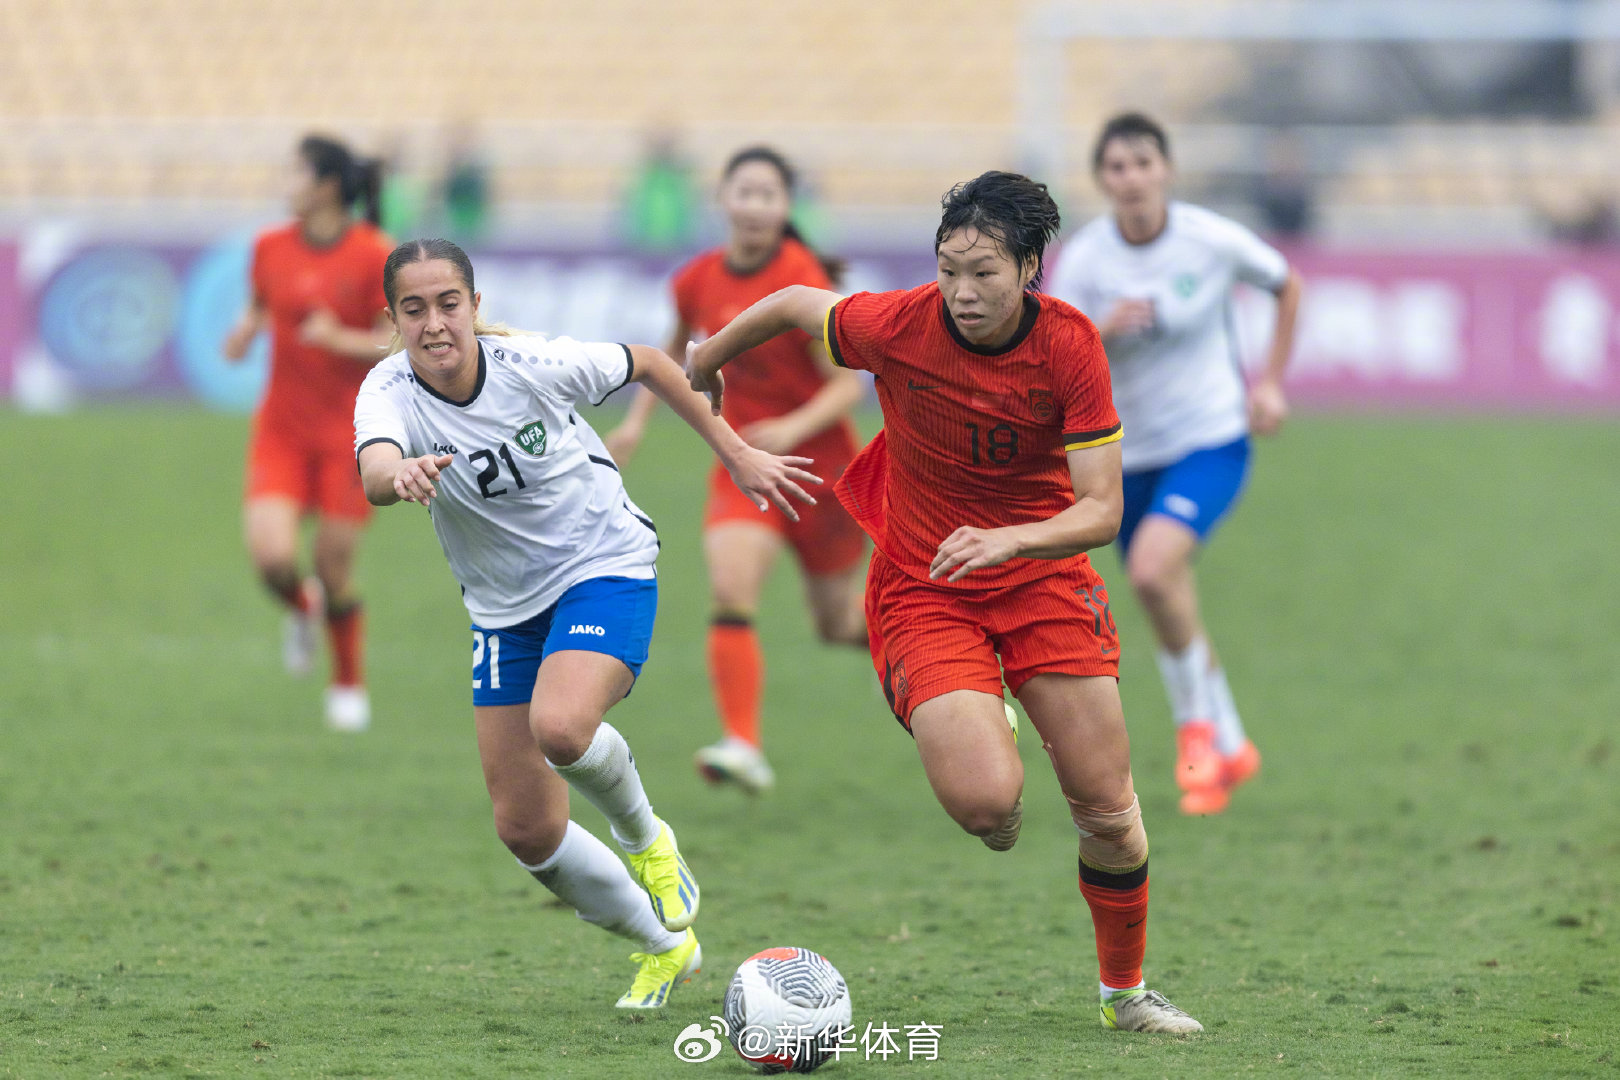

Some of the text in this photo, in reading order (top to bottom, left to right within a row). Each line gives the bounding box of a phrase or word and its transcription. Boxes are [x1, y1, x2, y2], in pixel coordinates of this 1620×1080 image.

[520, 426, 543, 446] UFA
[965, 422, 1018, 465] 18
[469, 443, 526, 499] 21
[568, 624, 606, 636] JAKO
